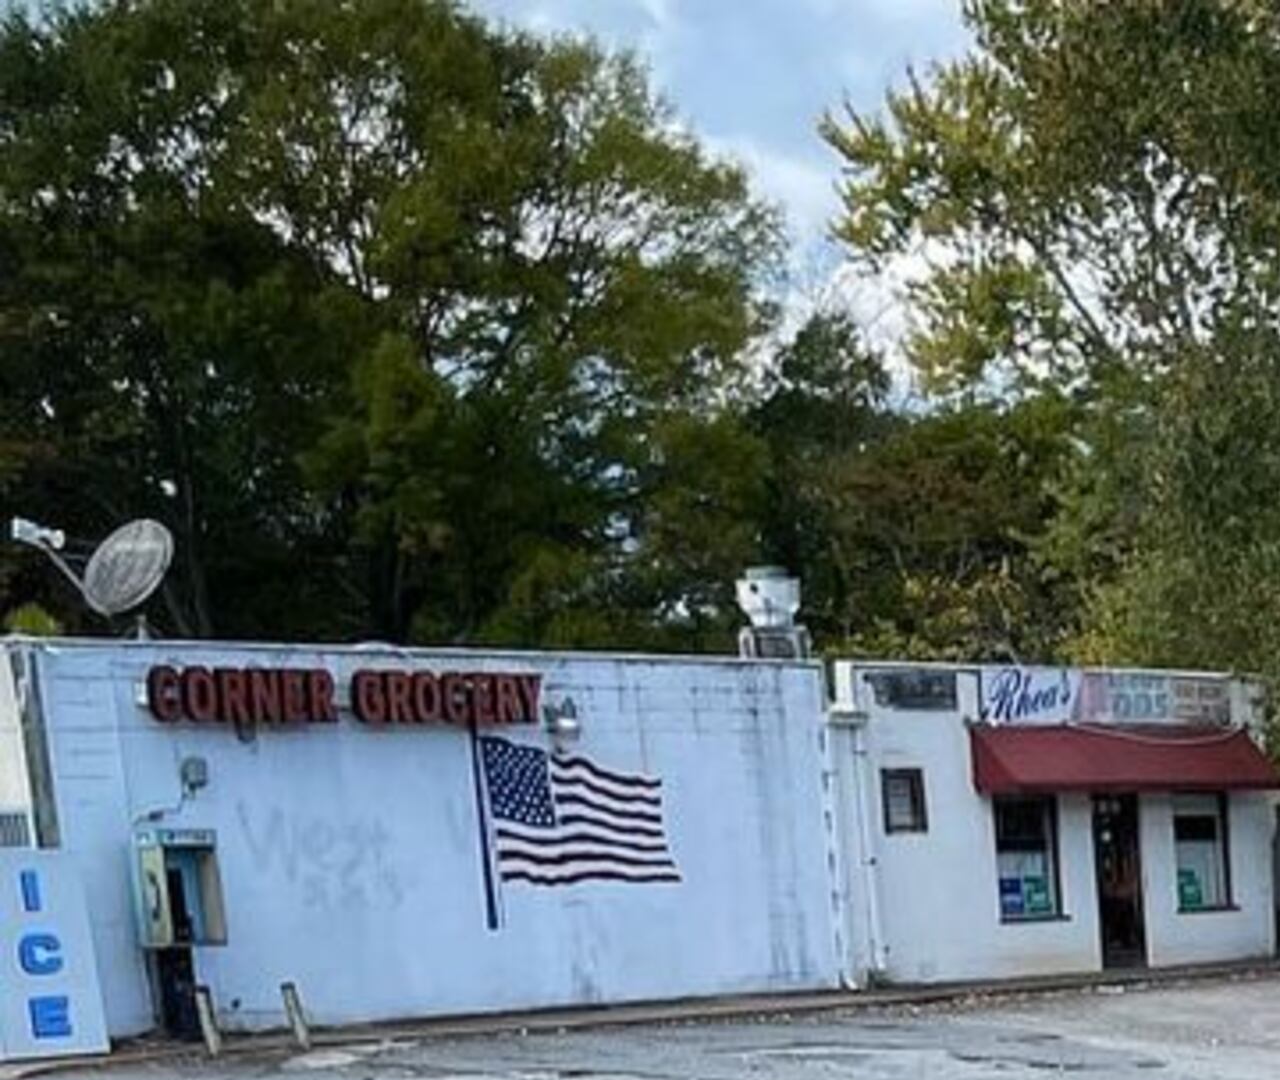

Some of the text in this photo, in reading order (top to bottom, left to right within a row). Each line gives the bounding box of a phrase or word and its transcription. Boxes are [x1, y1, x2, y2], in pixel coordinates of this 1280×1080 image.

[147, 666, 542, 725] CORNER GROCERY
[18, 869, 72, 1039] ICE
